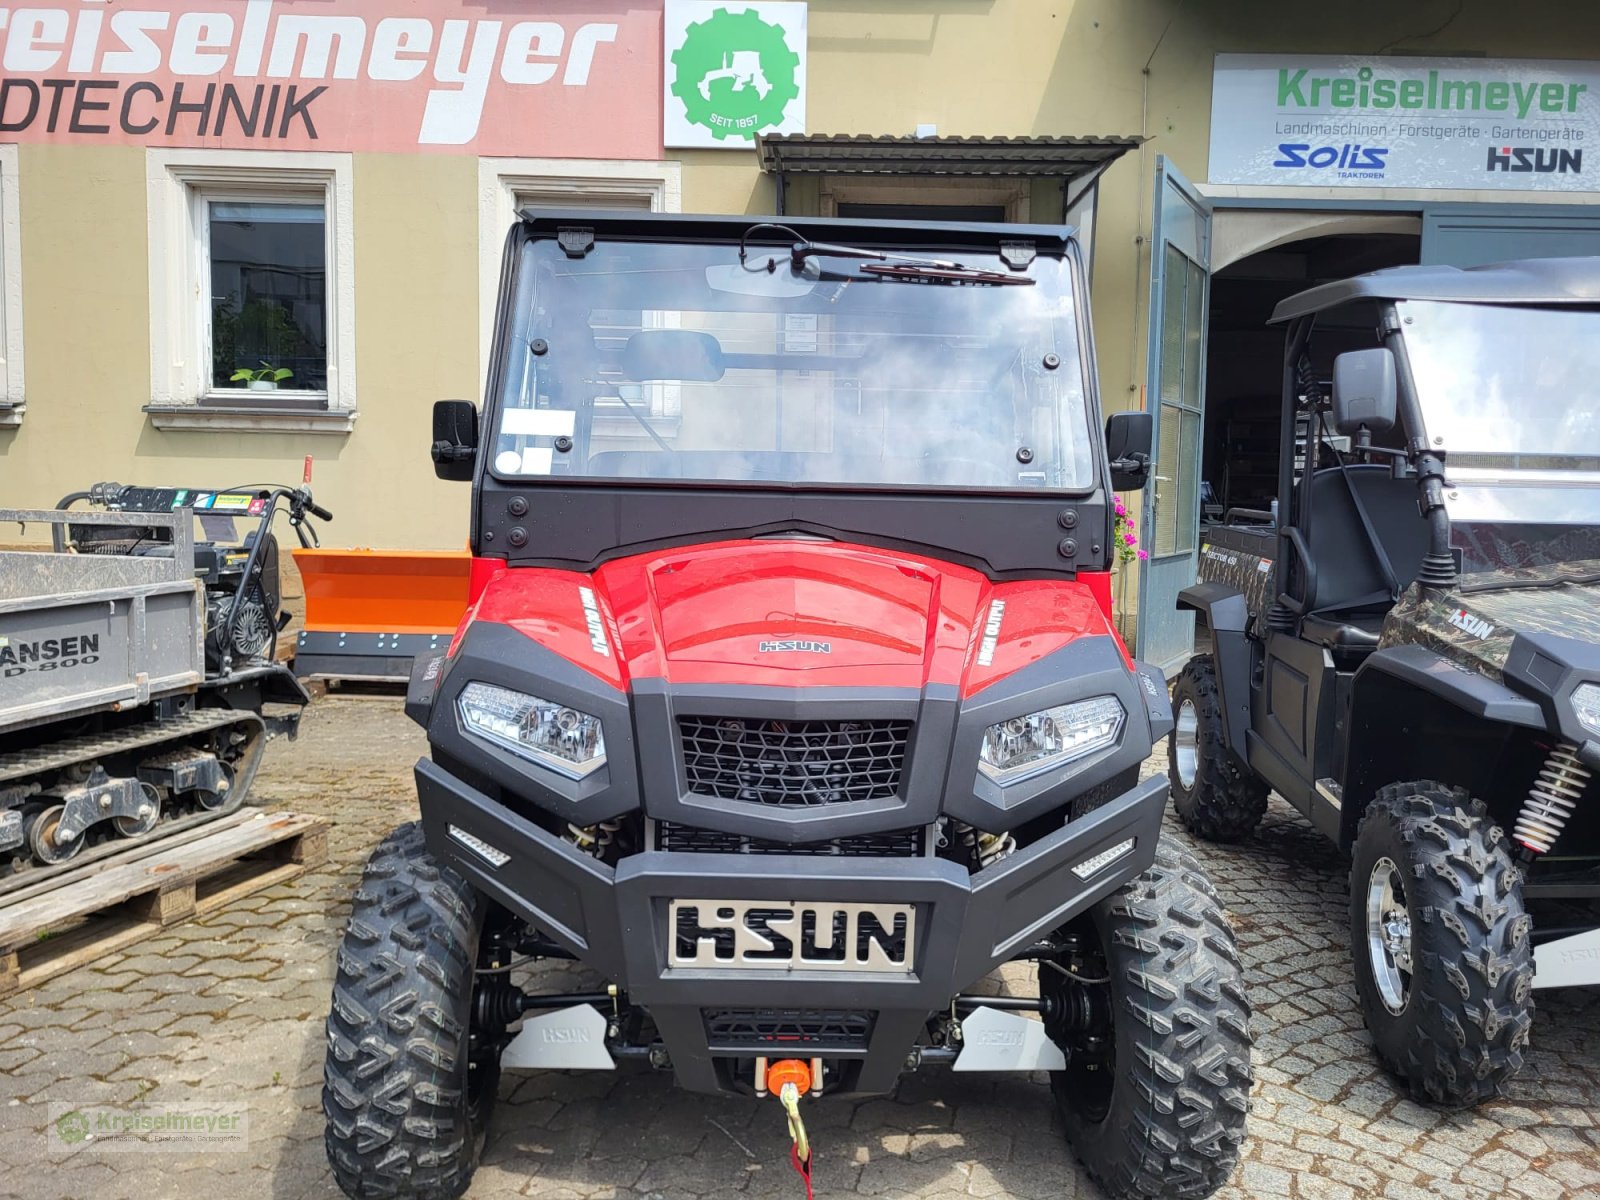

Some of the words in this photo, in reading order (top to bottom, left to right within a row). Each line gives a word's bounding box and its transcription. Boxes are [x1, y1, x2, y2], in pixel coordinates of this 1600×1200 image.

[0, 0, 618, 144] eiselmeyer
[1277, 66, 1587, 119] Kreiselmeyer
[710, 113, 733, 128] SEIT
[735, 114, 758, 128] 1857
[1275, 121, 1387, 136] Landmaschinen
[1399, 124, 1480, 140] Forstgeräte
[1491, 126, 1584, 142] Gartengeräte
[1486, 146, 1583, 173] HSUN
[1447, 608, 1495, 641] HSUN
[0, 634, 99, 667] ANSEN
[760, 640, 831, 654] HSUN
[5, 655, 100, 678] D-800
[675, 906, 908, 965] HSUN
